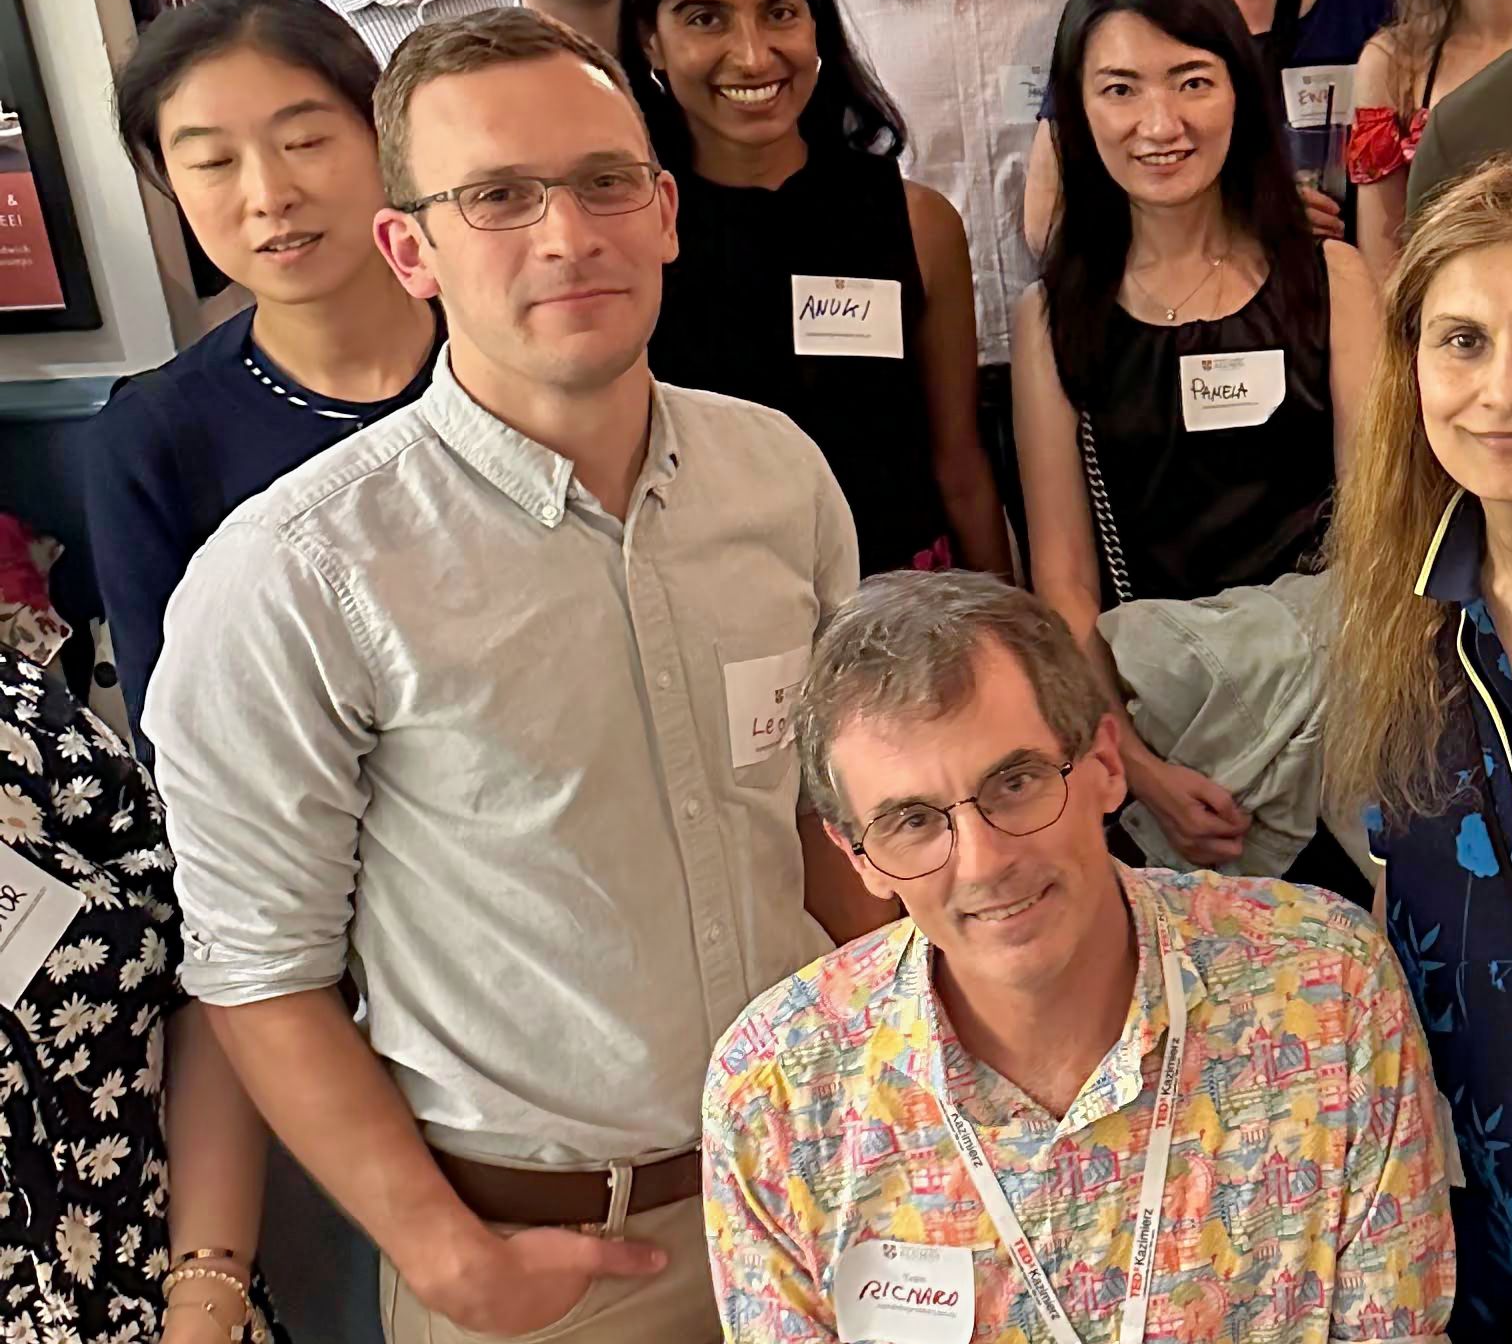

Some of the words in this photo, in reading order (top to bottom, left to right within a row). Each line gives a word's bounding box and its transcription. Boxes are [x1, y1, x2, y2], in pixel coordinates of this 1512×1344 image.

[7, 193, 18, 206] &
[799, 295, 870, 321] ANUKI
[1190, 377, 1248, 402] PAMELA
